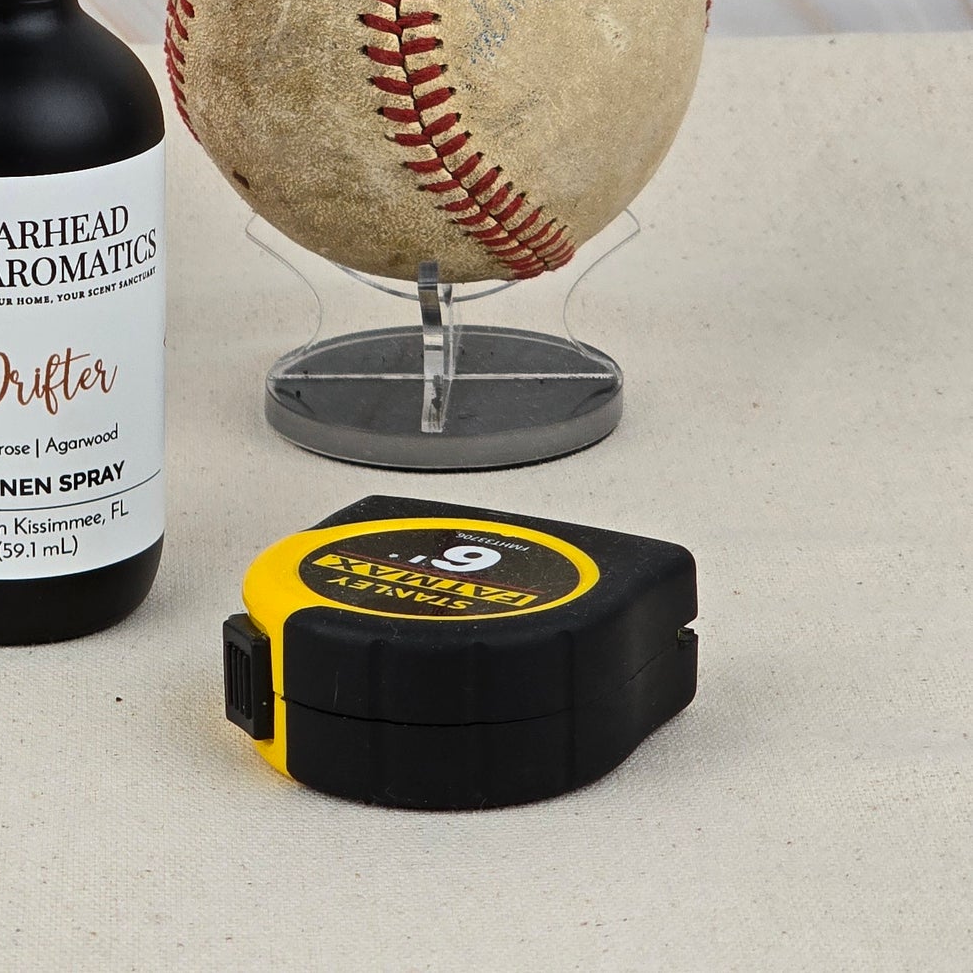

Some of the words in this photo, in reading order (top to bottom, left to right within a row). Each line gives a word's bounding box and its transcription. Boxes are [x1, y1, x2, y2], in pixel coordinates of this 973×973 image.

[17, 295, 53, 305] HOME,
[57, 291, 85, 302] YOUR
[88, 283, 116, 297] SCENT
[119, 266, 156, 289] SANCTUARY
[45, 423, 119, 455] Agarwood
[59, 460, 125, 491] SPRAY
[14, 512, 106, 535] Kissimmee,
[111, 500, 129, 520] FL
[43, 535, 78, 557] mL)
[328, 578, 475, 610] STANLEY
[329, 555, 529, 605] FATMAX
